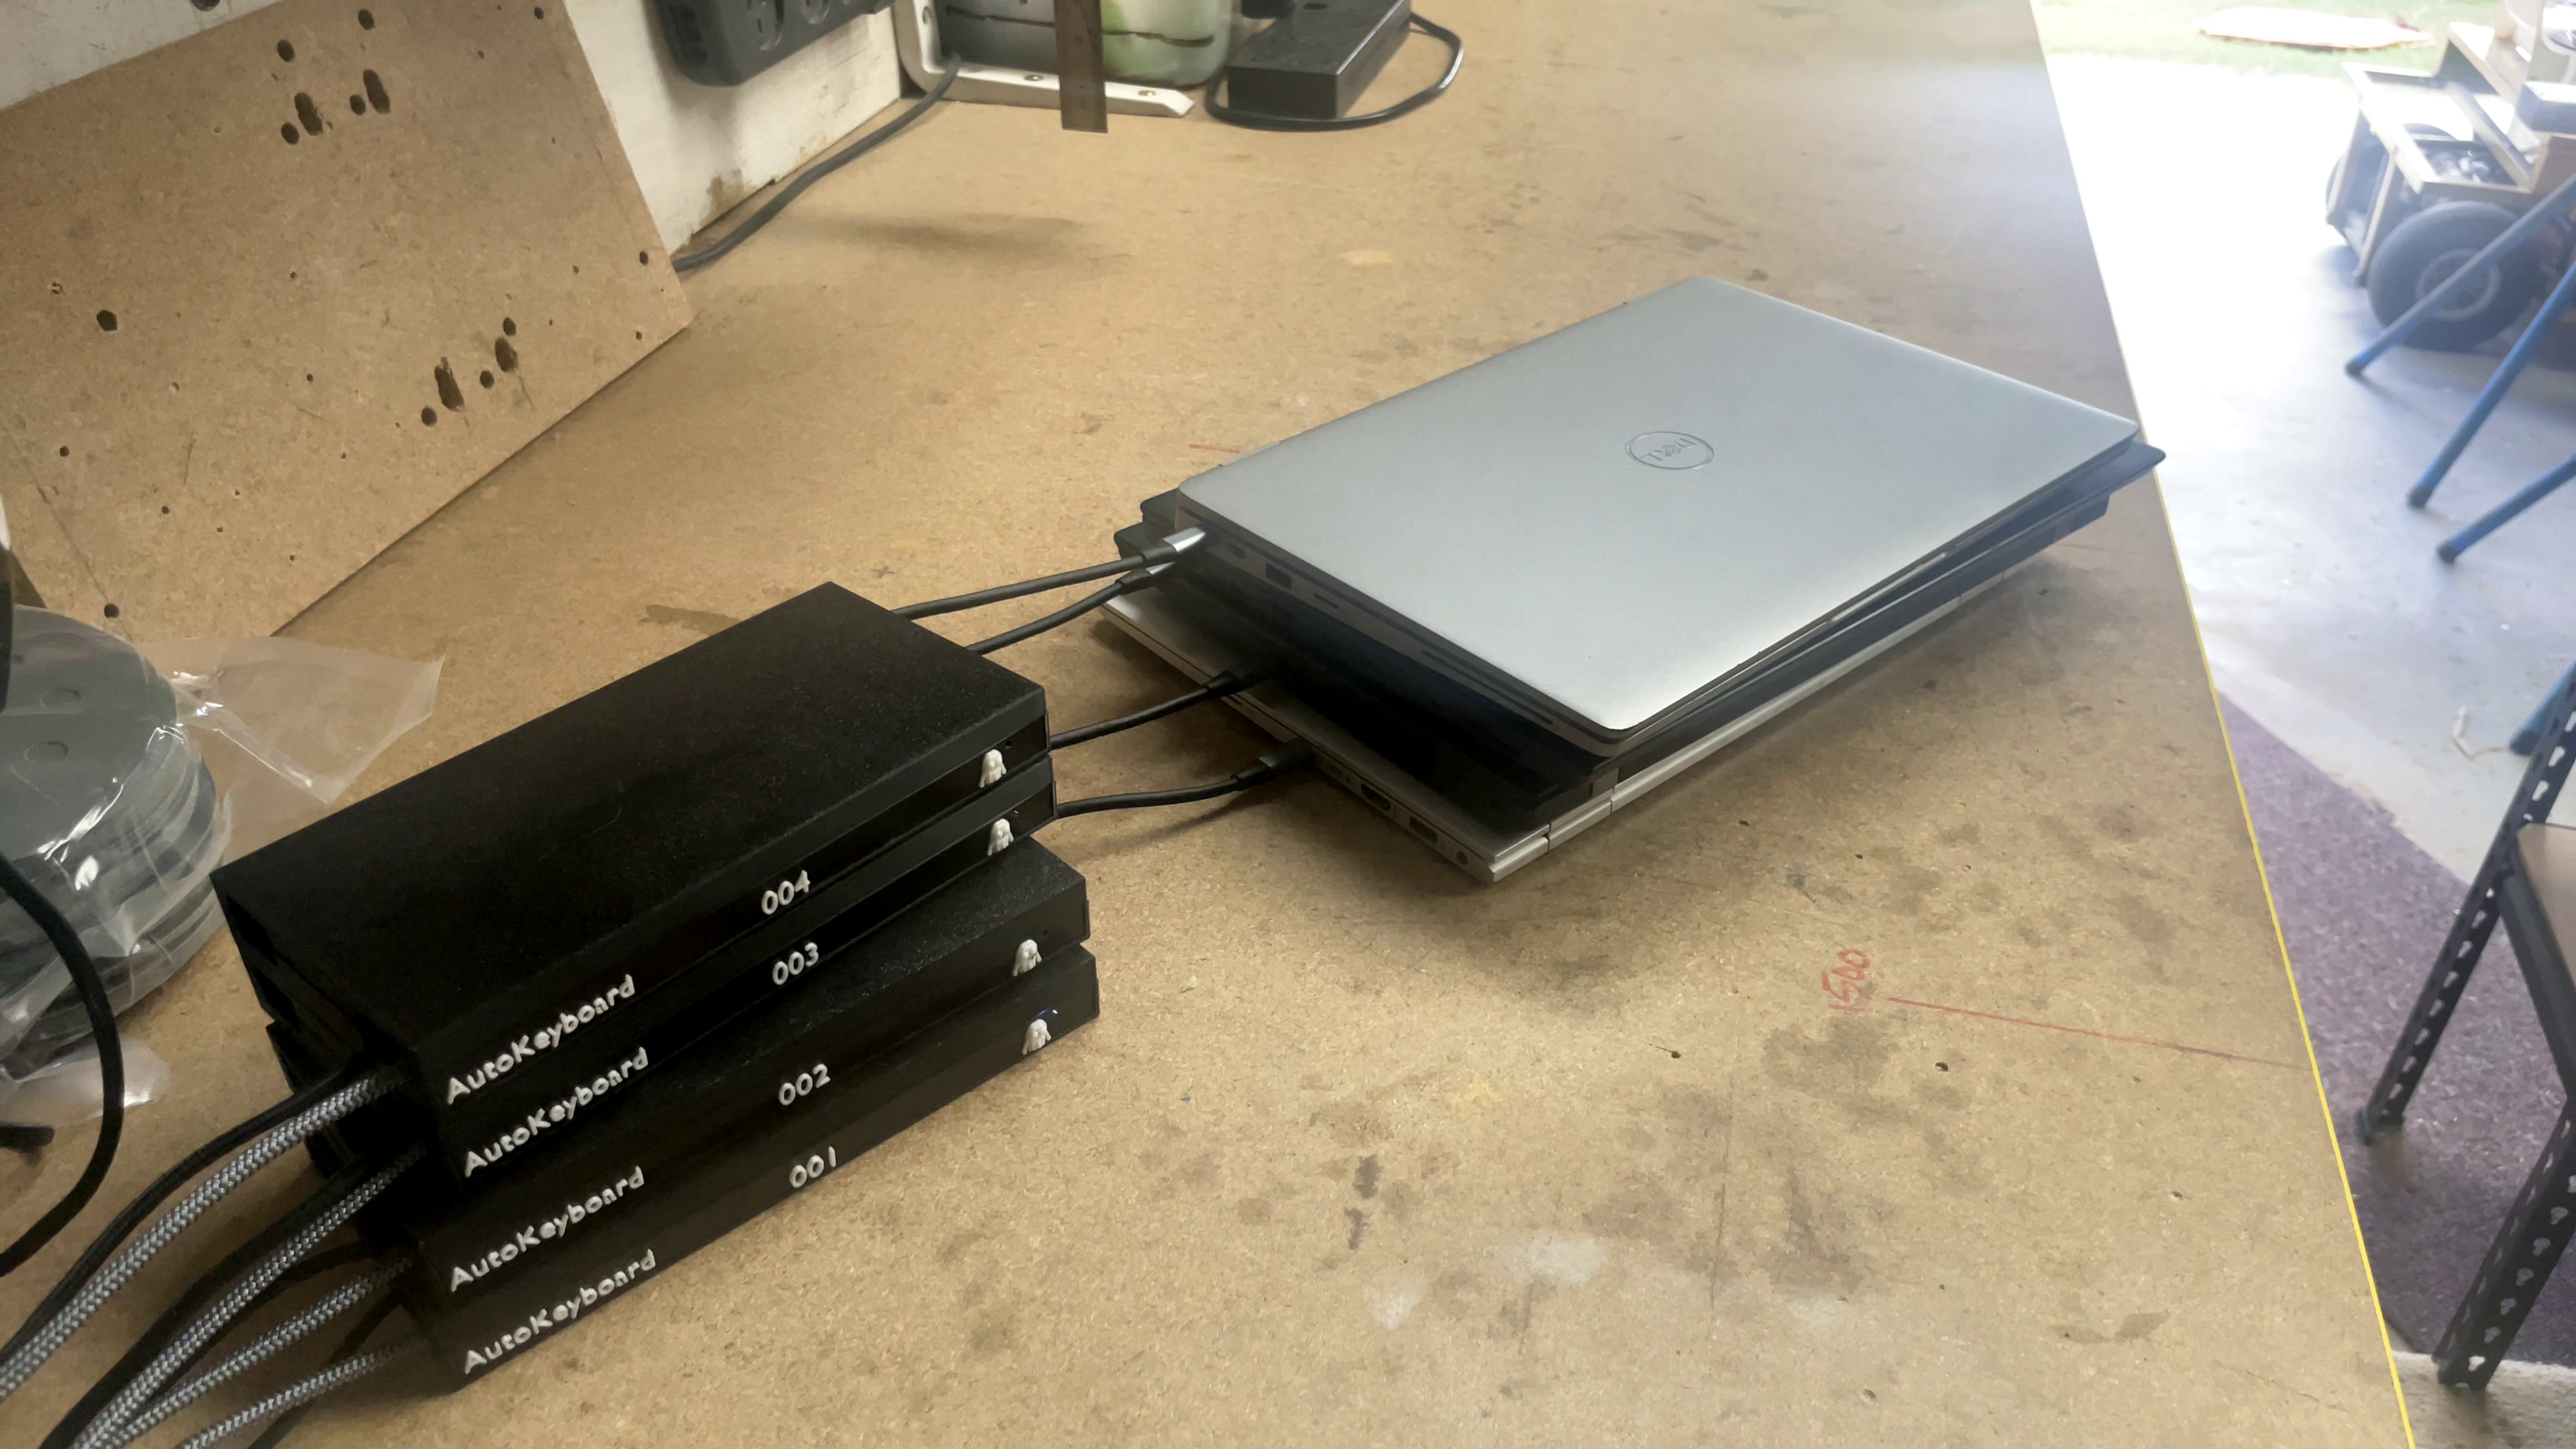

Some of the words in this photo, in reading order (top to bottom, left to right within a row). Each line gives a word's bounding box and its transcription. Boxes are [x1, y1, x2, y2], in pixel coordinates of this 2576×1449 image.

[447, 973, 636, 1104] AutoKeyboard
[761, 869, 810, 915] 004
[465, 1046, 649, 1177] AutoKeyboard
[772, 942, 819, 985] 003
[1821, 949, 1870, 1011] 1500
[450, 1165, 645, 1292] AutoKeyboard
[778, 1064, 831, 1106] 002
[464, 1248, 656, 1375] AutoKeyboard
[789, 1146, 837, 1188] 001
